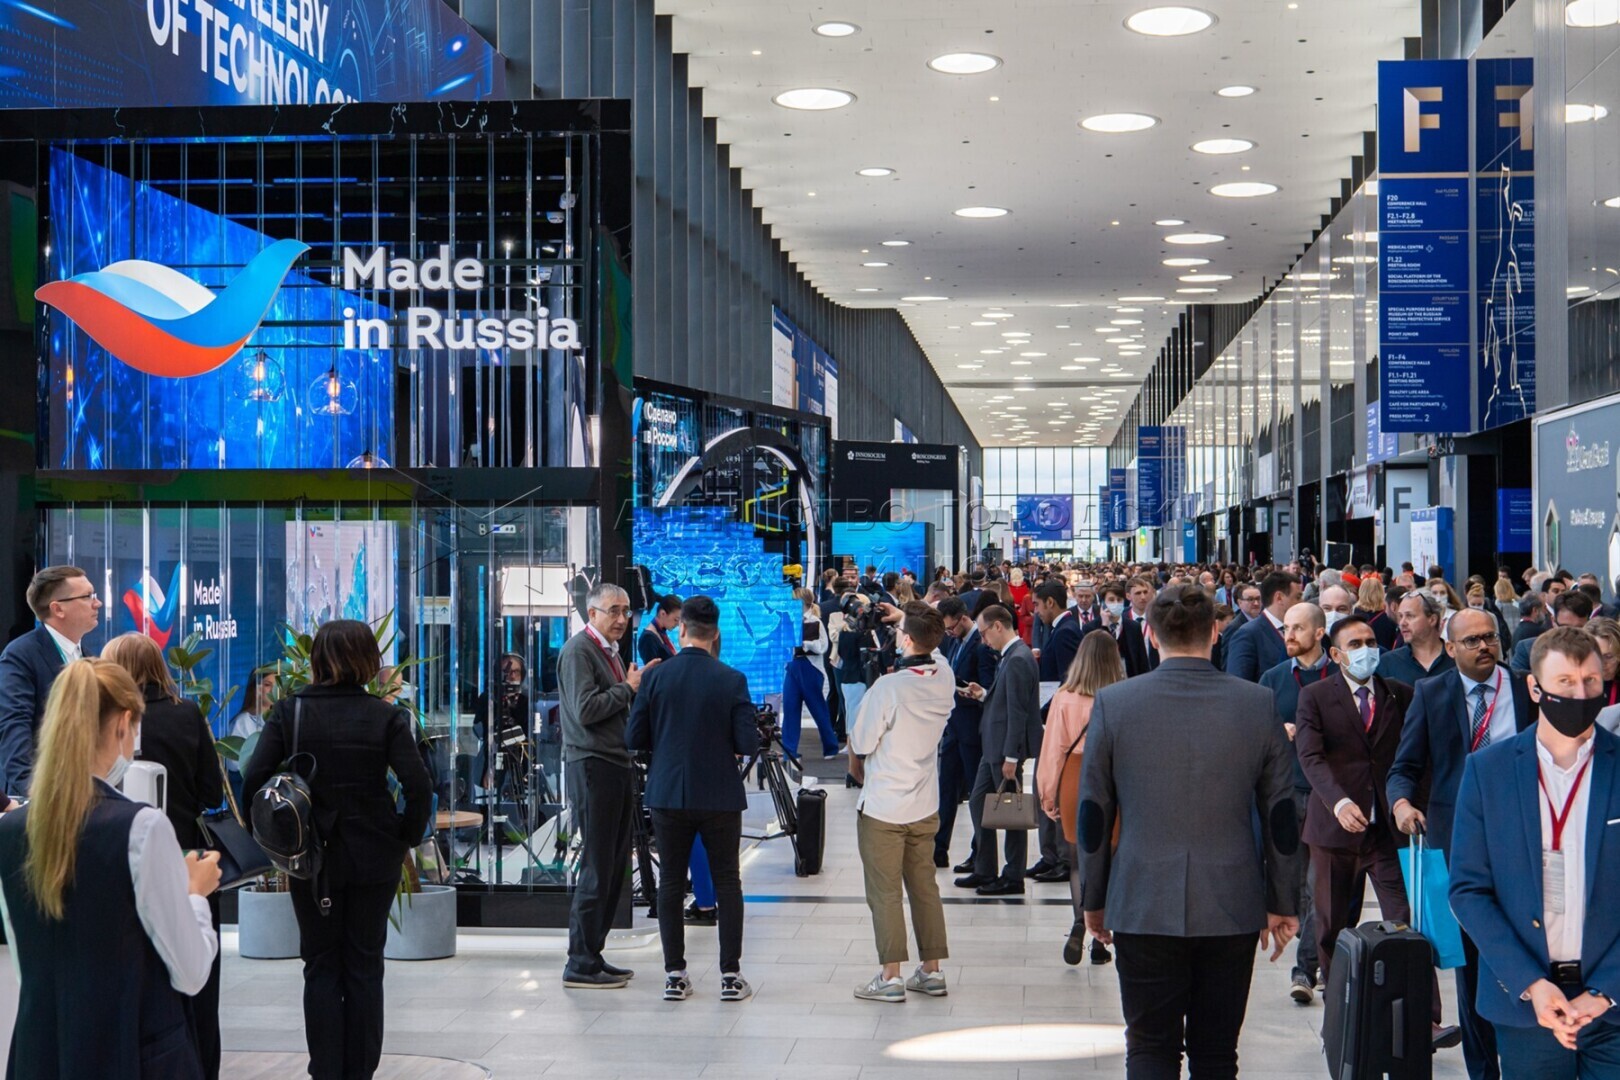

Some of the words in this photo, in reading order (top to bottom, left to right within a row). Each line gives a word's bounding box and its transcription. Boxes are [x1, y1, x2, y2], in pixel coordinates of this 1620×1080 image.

[229, 0, 329, 63] LLERY
[147, 0, 189, 56] OF
[194, 0, 360, 106] TECHNOL
[1404, 86, 1443, 152] F
[343, 245, 485, 290] Made
[343, 308, 389, 350] in
[407, 306, 581, 350] Russia
[644, 402, 677, 424] Сделано
[1424, 414, 1430, 422] 2
[653, 427, 678, 448] России
[1393, 487, 1412, 523] F
[1278, 512, 1290, 536] F
[194, 578, 222, 605] Made
[206, 613, 237, 640] Russia
